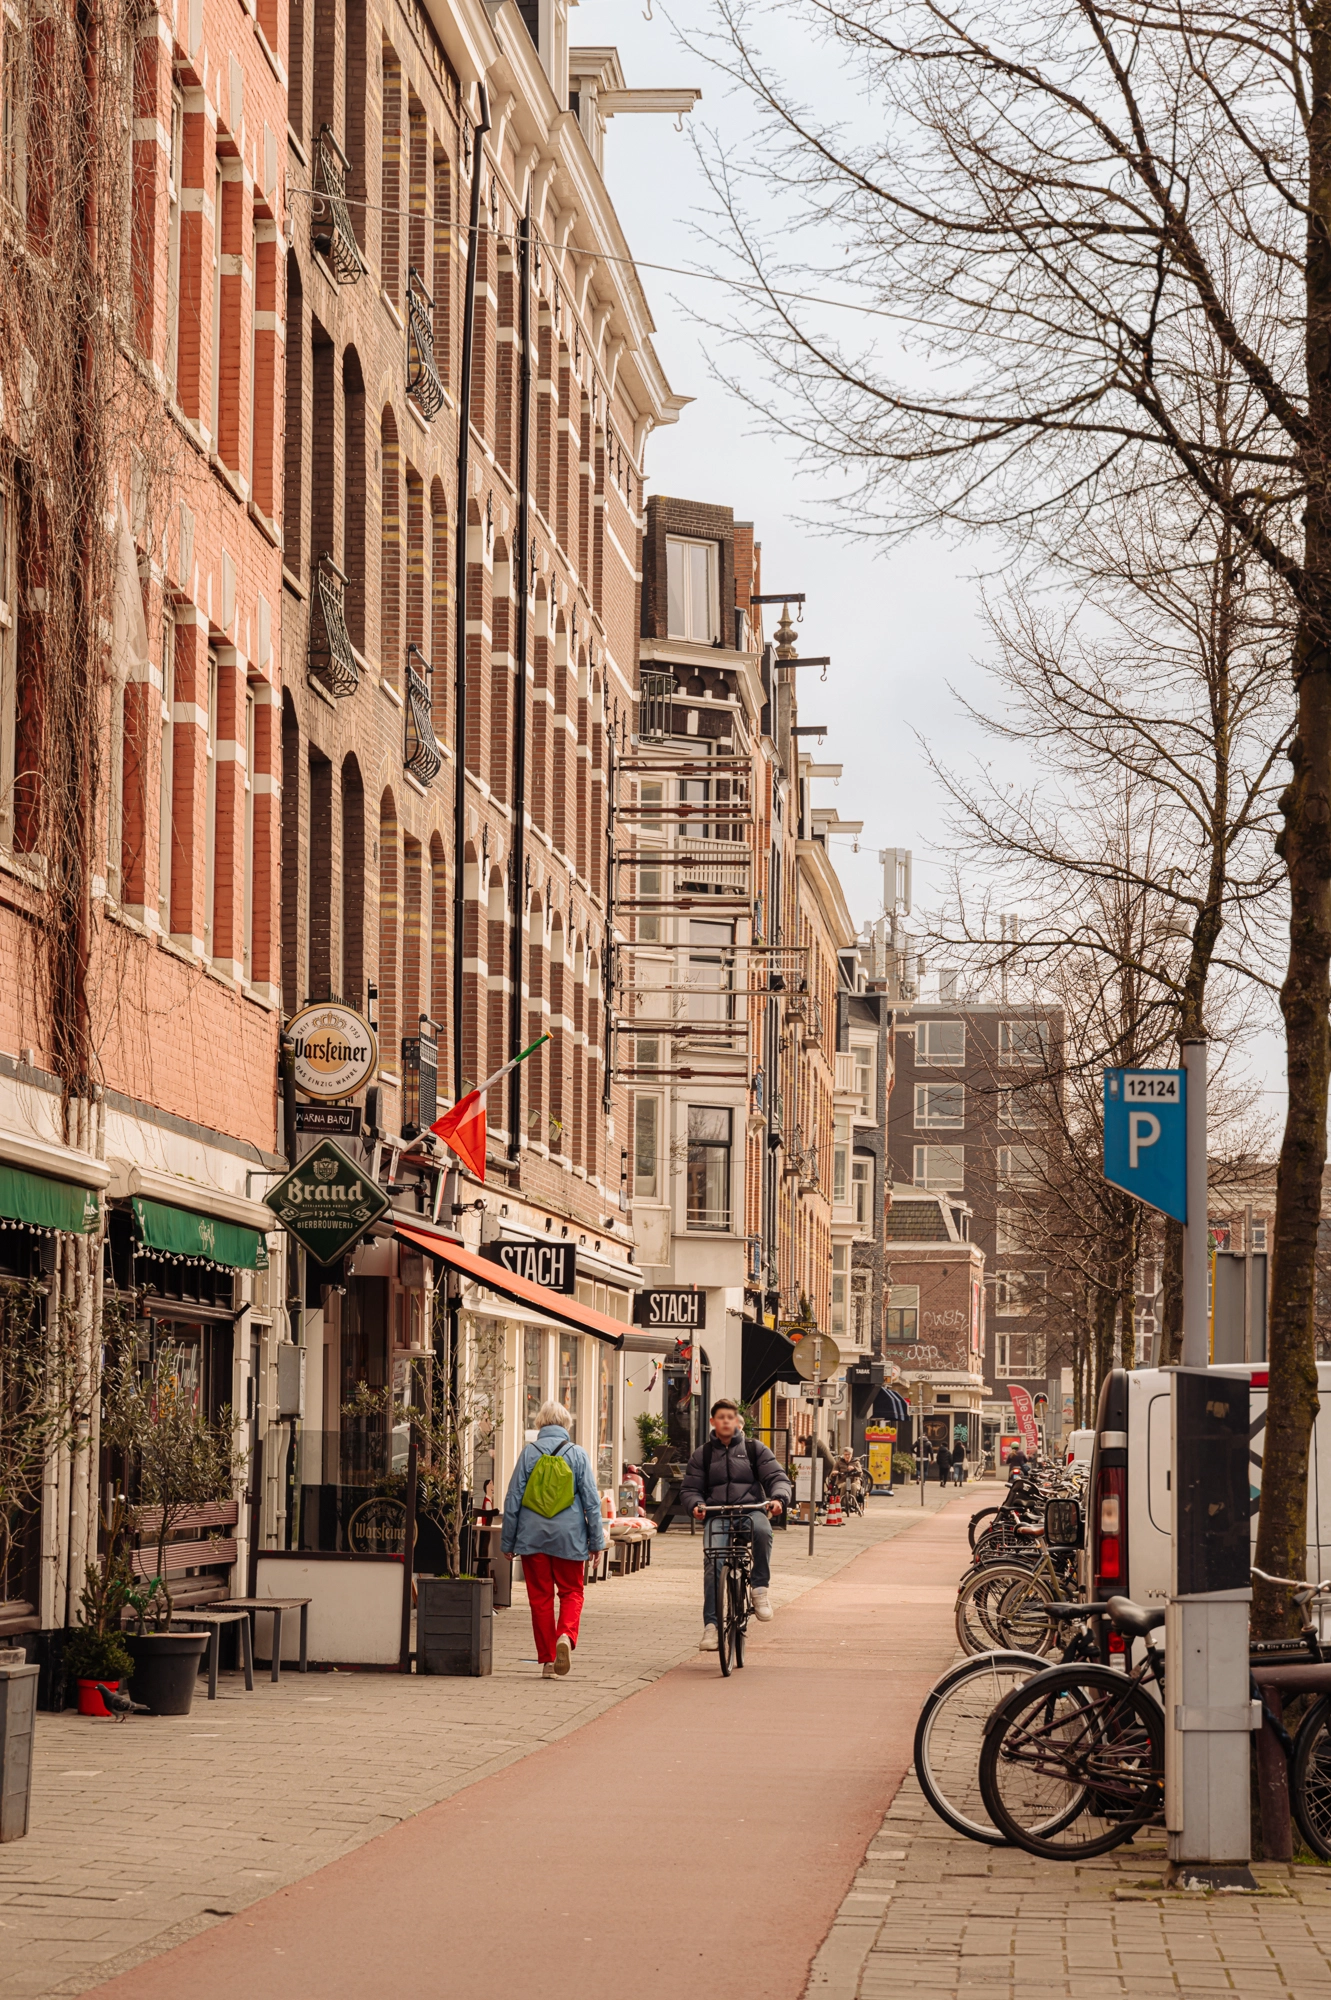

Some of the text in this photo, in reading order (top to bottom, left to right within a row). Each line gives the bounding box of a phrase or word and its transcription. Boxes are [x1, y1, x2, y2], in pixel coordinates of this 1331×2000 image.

[298, 1022, 361, 1039] SEIT 1753
[295, 1065, 358, 1087] DAS EINZIG WAHRE
[1128, 1080, 1176, 1097] 12124
[296, 1113, 350, 1125] WARNA BARU
[1129, 1111, 1162, 1169] P
[287, 1177, 364, 1204] Brand
[314, 1210, 336, 1218] 1340
[297, 1220, 353, 1229] BIERBROUWERIJ
[500, 1246, 564, 1286] STACH
[650, 1293, 698, 1323] STACH
[1021, 1413, 1038, 1451] Stelling
[355, 1522, 407, 1541] Warsteine
[1144, 1589, 1168, 1598] TR
